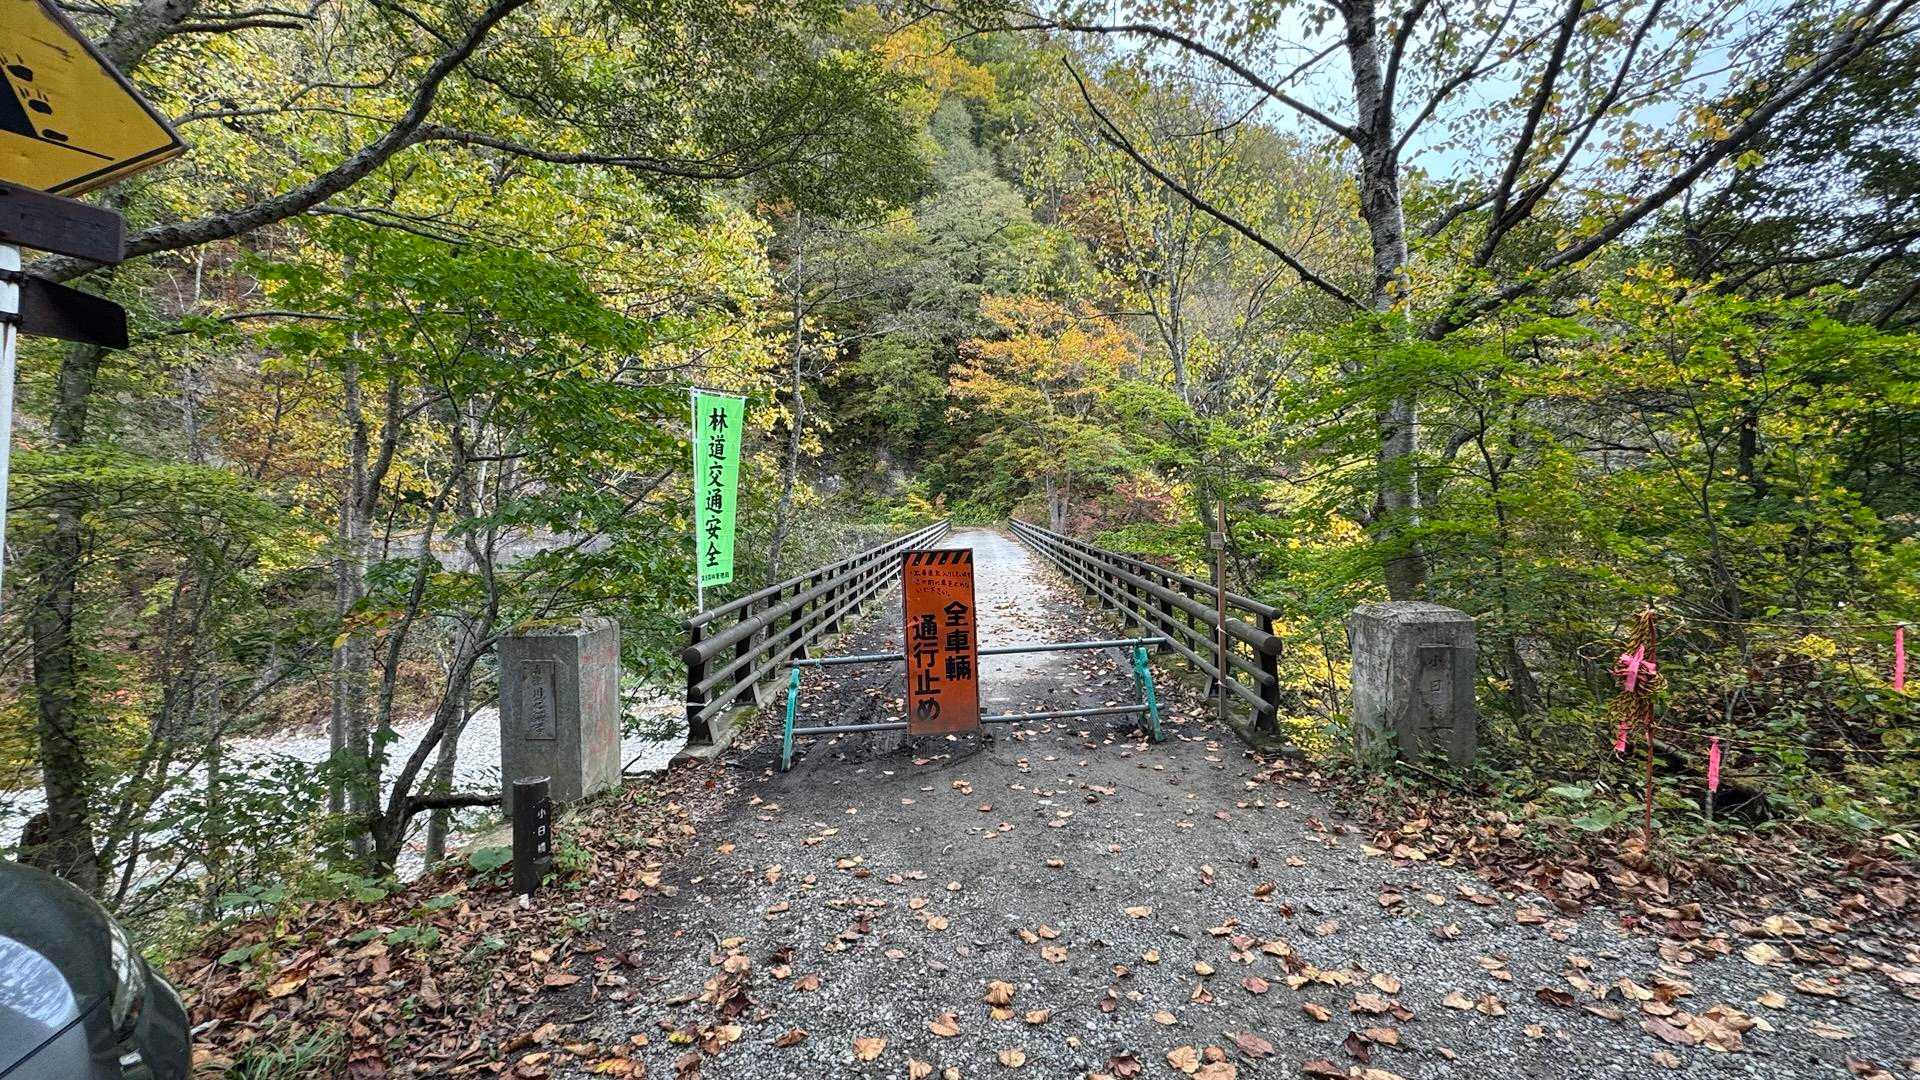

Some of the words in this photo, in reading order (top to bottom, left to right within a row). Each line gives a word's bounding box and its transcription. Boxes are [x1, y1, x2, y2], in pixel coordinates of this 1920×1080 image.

[705, 407, 729, 568] 林道交通安全
[912, 614, 942, 721] 通行止め
